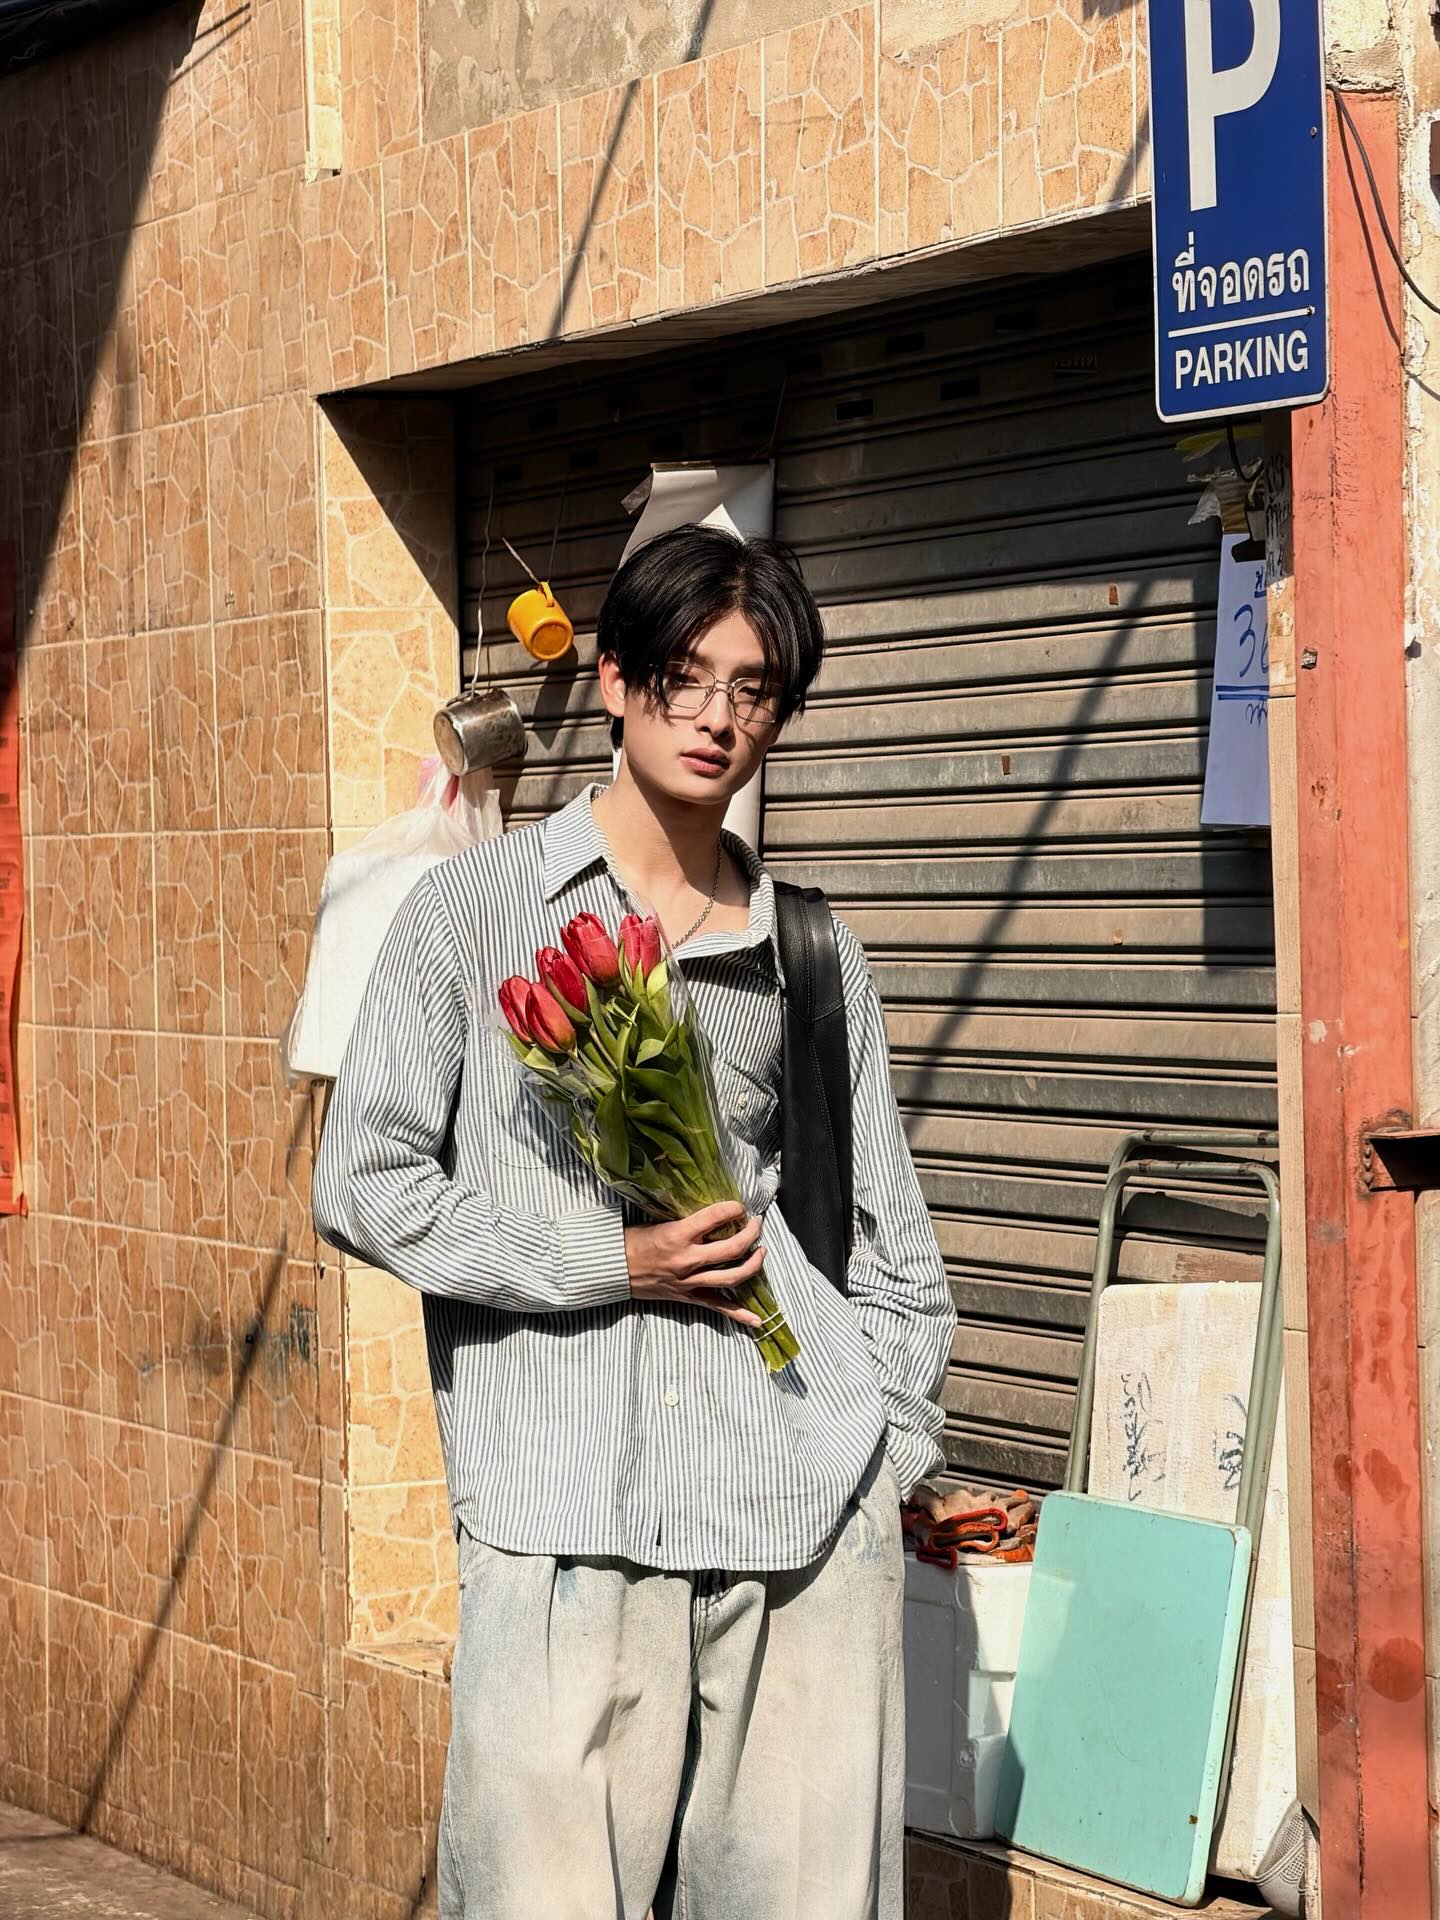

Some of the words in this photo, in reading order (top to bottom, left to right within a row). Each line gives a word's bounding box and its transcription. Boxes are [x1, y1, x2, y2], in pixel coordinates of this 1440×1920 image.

[1184, 0, 1281, 211] P
[1172, 231, 1310, 313] ที่จอดรถ
[1175, 330, 1309, 389] PARKING
